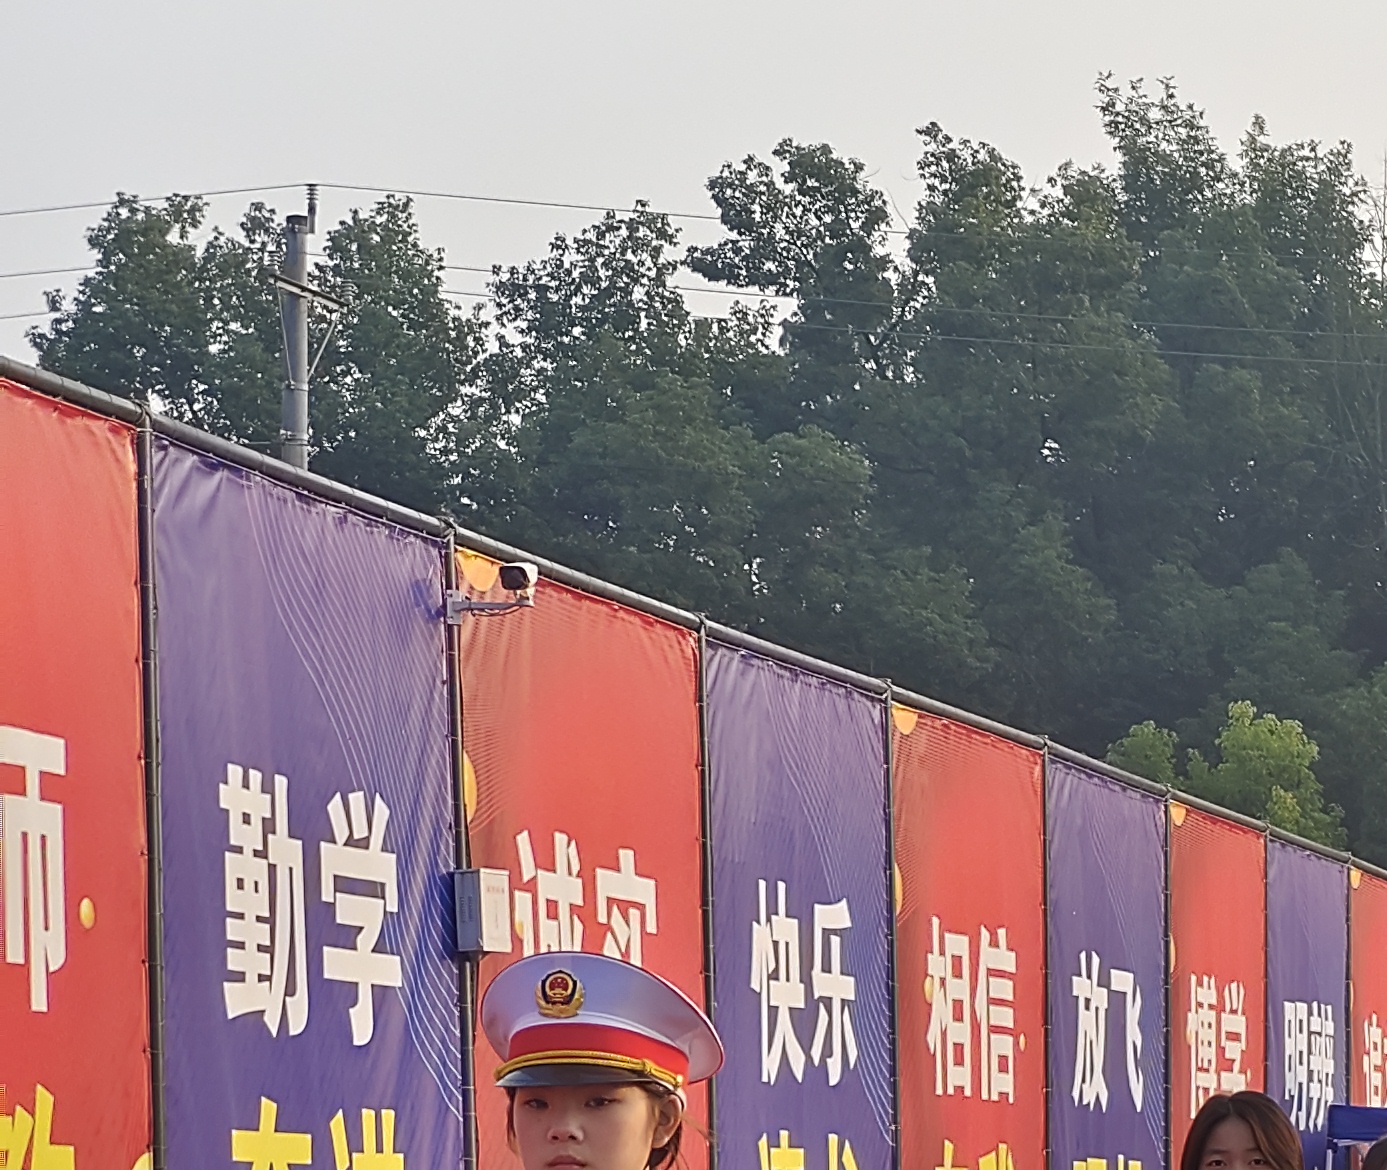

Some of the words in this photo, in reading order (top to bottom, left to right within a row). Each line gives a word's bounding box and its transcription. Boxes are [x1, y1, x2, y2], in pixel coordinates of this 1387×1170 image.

[219, 764, 402, 1046] 勤学
[751, 879, 859, 1087] 快乐
[927, 916, 1018, 1104] 相信
[1071, 950, 1143, 1113] 放飞
[1187, 972, 1247, 1119] 博学
[1284, 1000, 1334, 1133] 明辨
